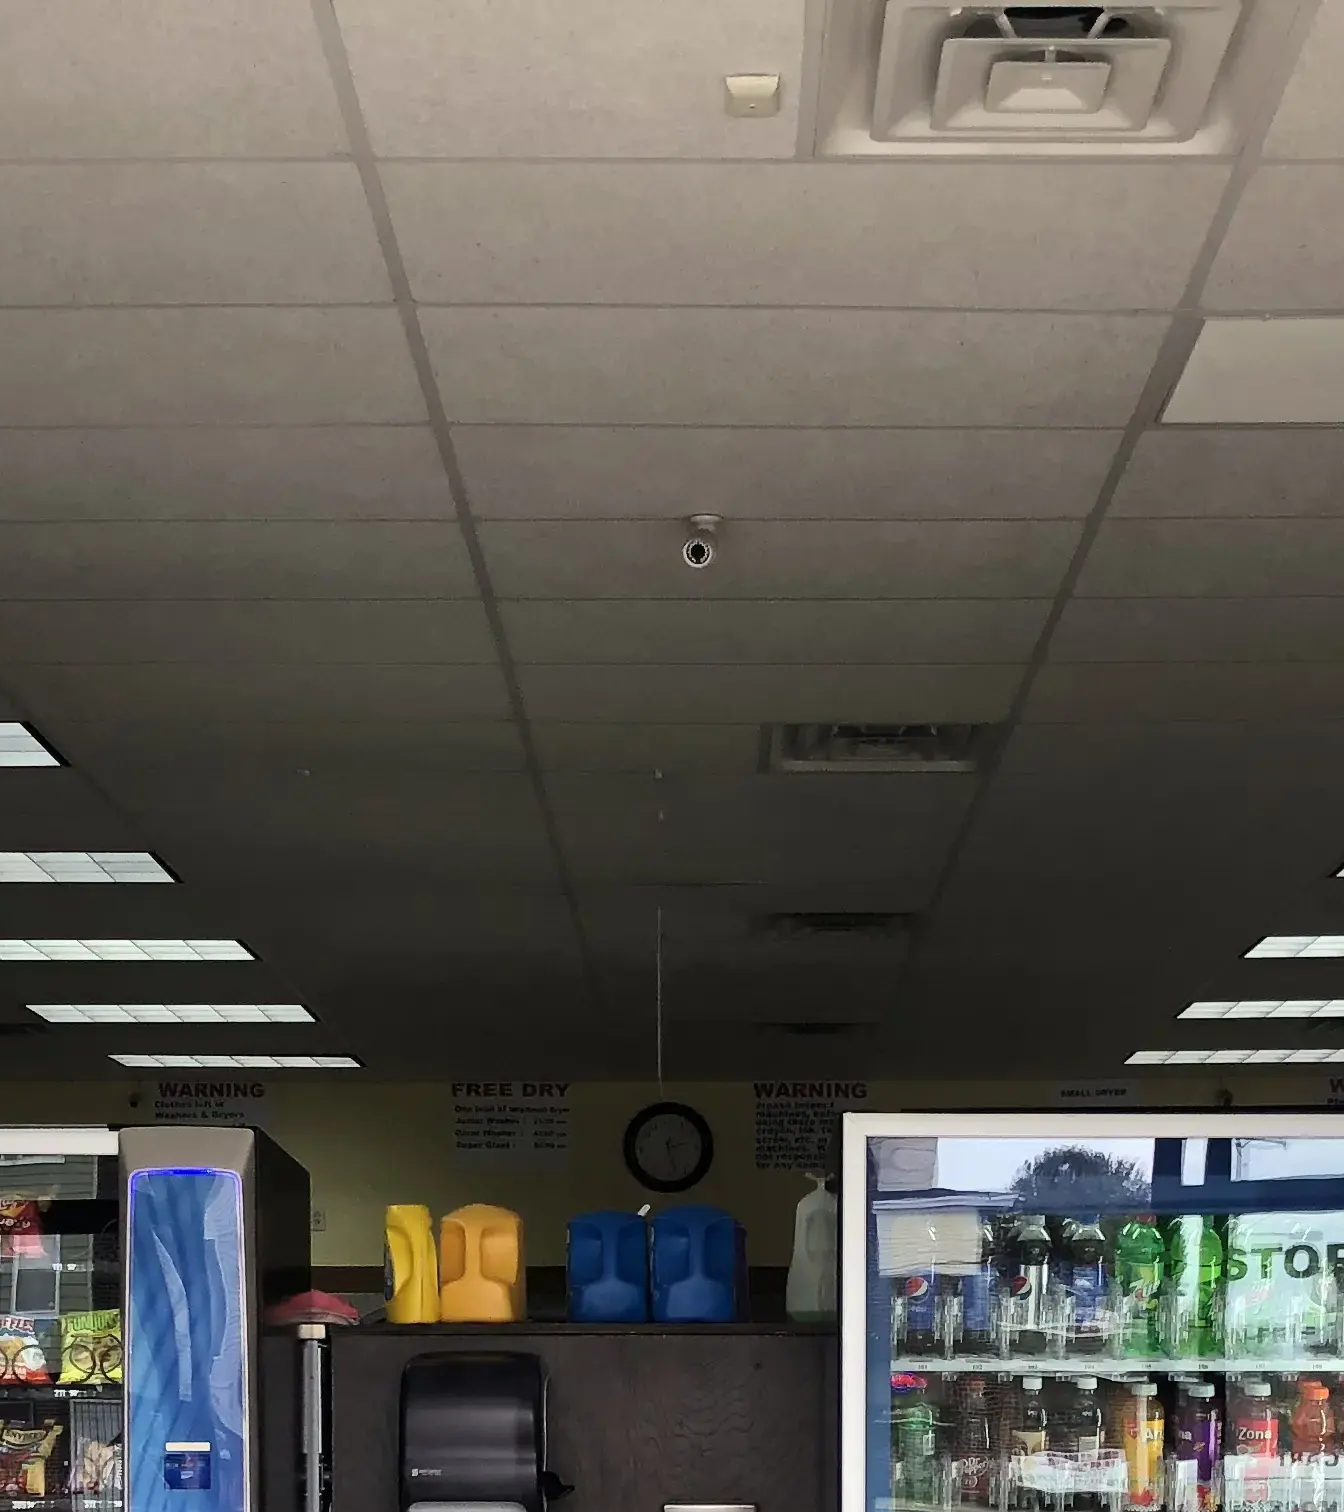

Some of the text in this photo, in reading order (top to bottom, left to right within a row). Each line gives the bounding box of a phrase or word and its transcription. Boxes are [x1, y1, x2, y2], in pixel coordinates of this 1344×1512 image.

[159, 1083, 265, 1098] WARNING
[452, 1083, 570, 1097] FREE DRY
[754, 1083, 867, 1098] WARNING
